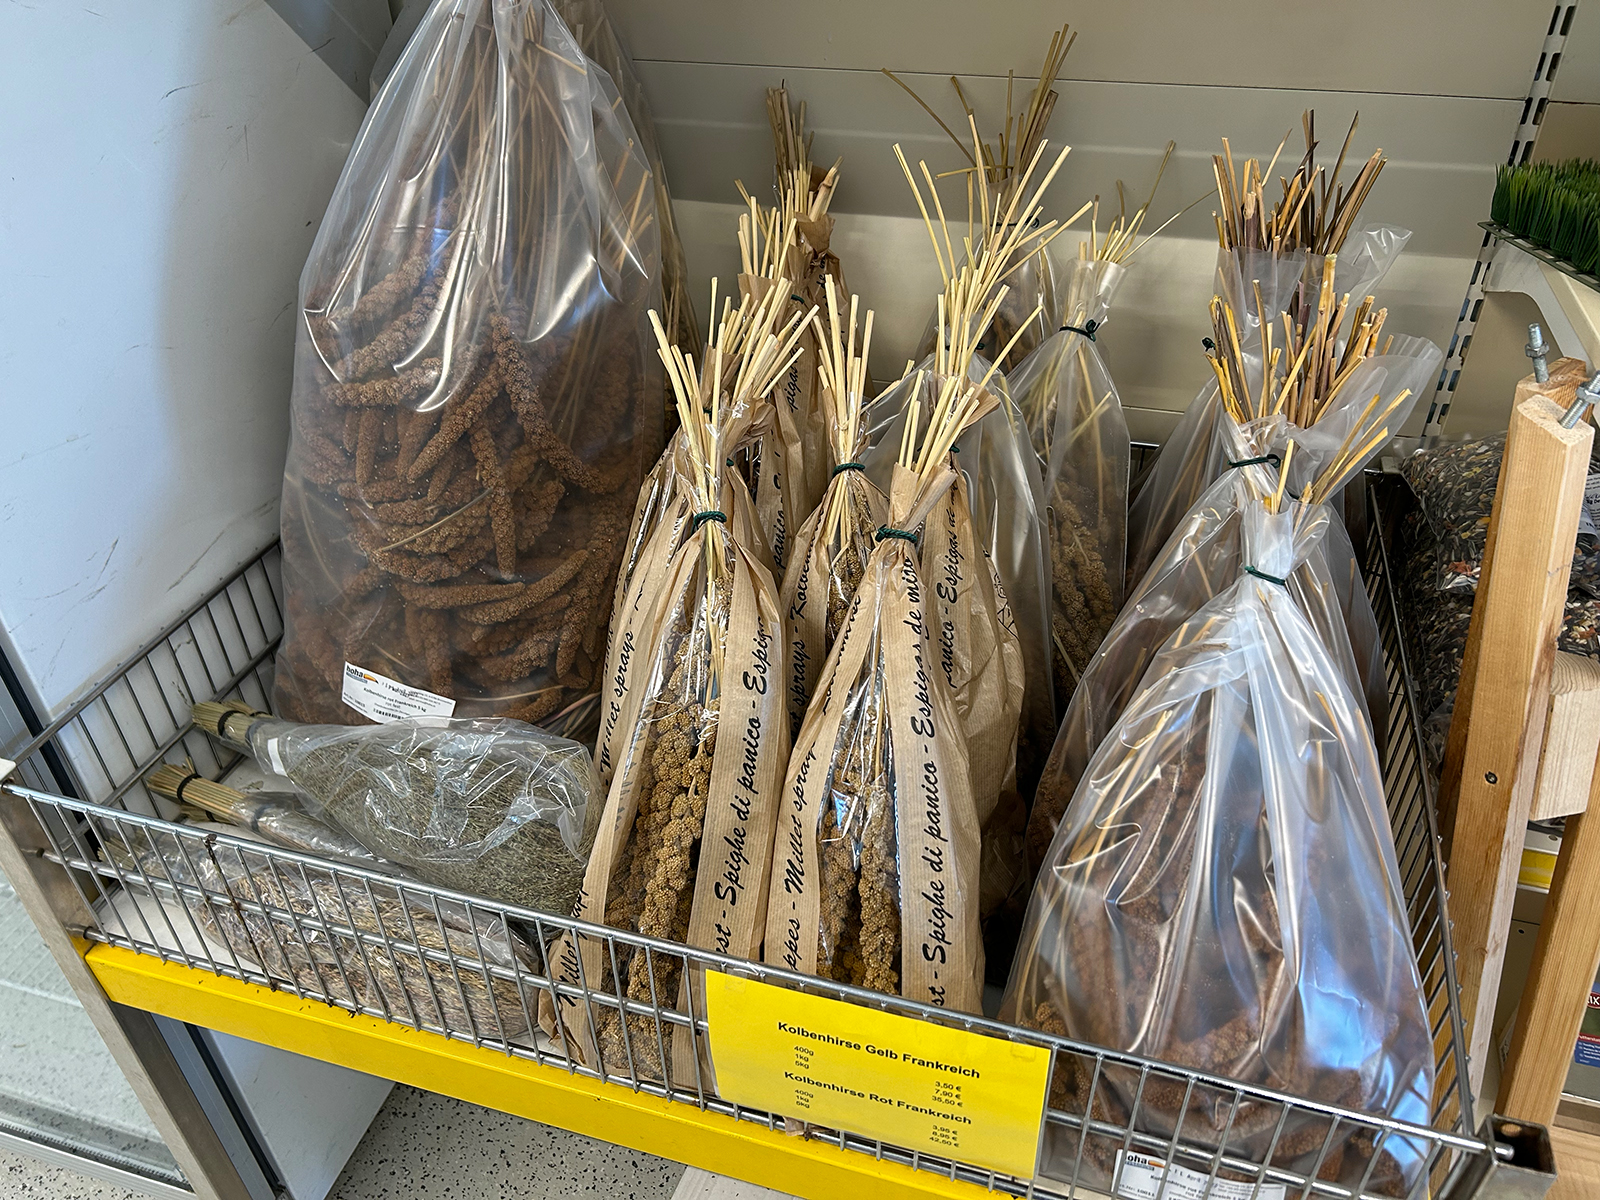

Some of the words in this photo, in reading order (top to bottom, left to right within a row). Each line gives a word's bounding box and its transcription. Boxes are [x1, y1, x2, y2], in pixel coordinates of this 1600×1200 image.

[937, 533, 964, 604] Espigas
[903, 609, 922, 636] de
[346, 664, 364, 678] hoha
[613, 630, 635, 697] sprays
[743, 616, 773, 695] Espig
[790, 638, 811, 707] sprays
[737, 716, 762, 795] panico
[730, 795, 751, 822] di
[924, 760, 948, 843] panico
[714, 827, 751, 906] Spighe
[785, 814, 804, 894] Millet
[921, 845, 944, 874] di
[783, 917, 801, 971] ppes
[921, 879, 954, 965] Spighe
[929, 985, 946, 1007] st
[778, 1021, 862, 1051] Kolbenhirse
[865, 1044, 898, 1060] Gelb
[902, 1053, 980, 1079] Frankreich
[794, 1046, 814, 1057] 400g
[935, 1081, 954, 1090] 3,50
[795, 1053, 809, 1062] 1kg
[934, 1088, 953, 1098] 7,90
[784, 1071, 865, 1098] Kolbenhirse
[869, 1093, 894, 1106] Rot
[897, 1100, 972, 1125] Frankreich
[794, 1060, 810, 1069] 5kg
[931, 1095, 955, 1106] 35,50
[794, 1089, 814, 1098] 400g
[796, 1095, 809, 1103] 1kg
[1126, 1154, 1148, 1165] oha
